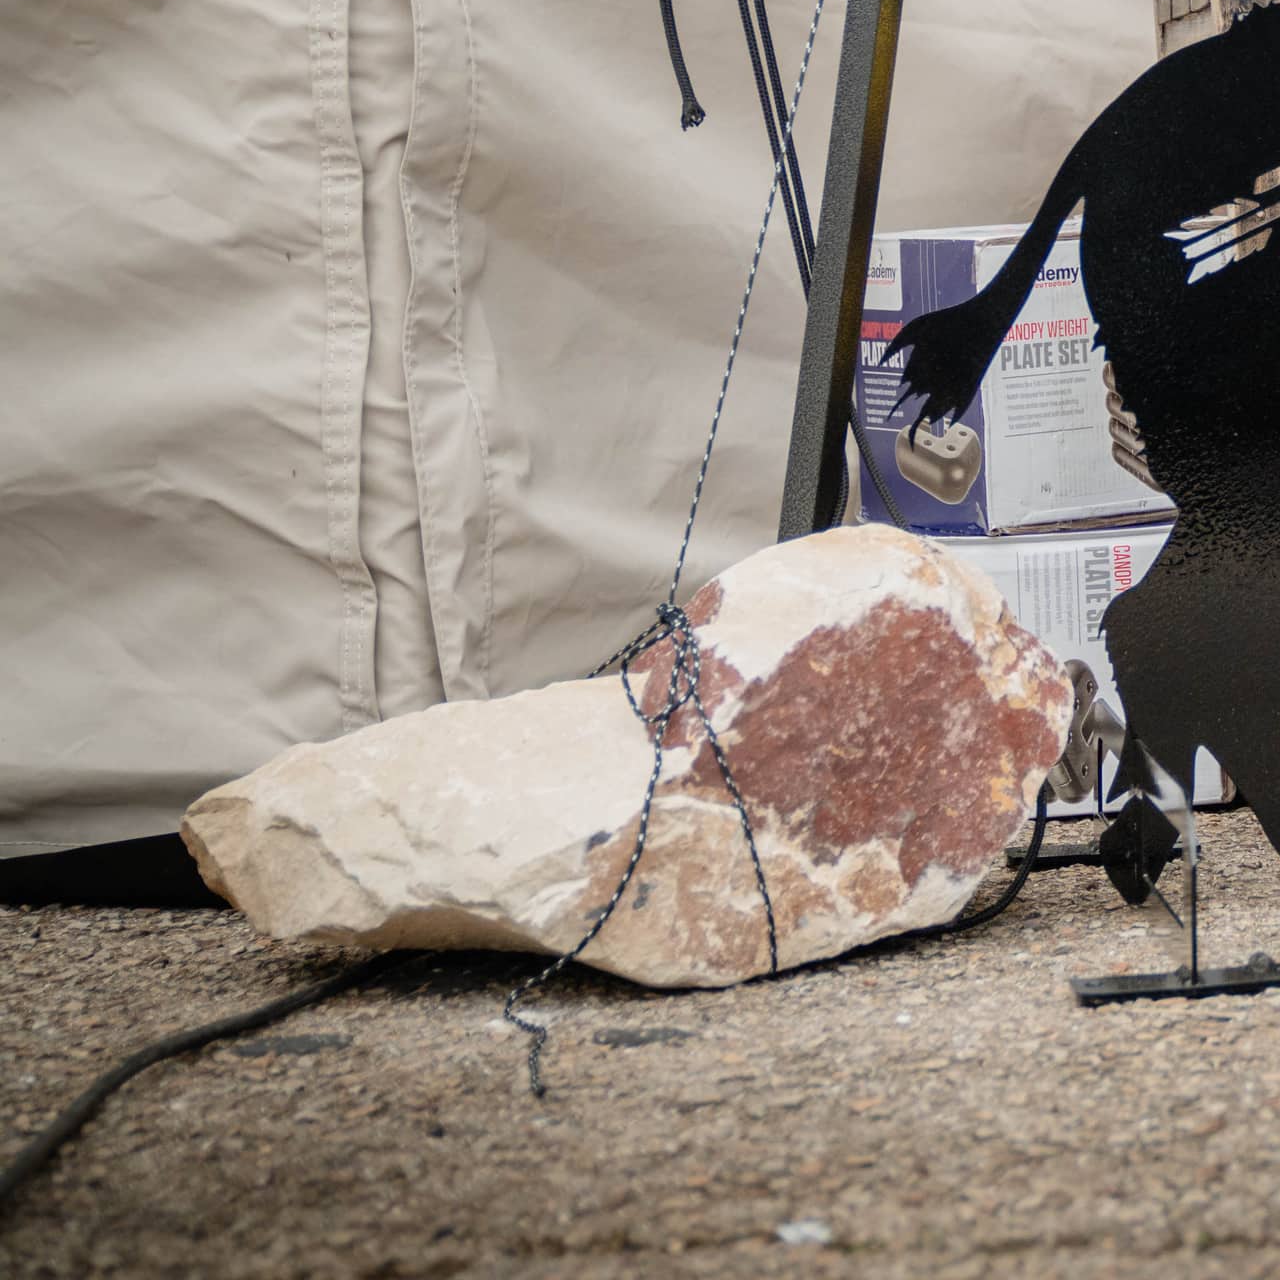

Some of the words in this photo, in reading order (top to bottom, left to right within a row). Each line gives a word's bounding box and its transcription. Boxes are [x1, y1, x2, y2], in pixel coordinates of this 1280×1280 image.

[1036, 267, 1079, 283] demy
[1003, 321, 1044, 341] ANOPY
[1047, 317, 1089, 338] WEIGHT
[1001, 341, 1053, 371] PLATE
[1058, 338, 1090, 366] SET
[1084, 546, 1111, 604] PLATE
[1113, 544, 1131, 592] CANOPY
